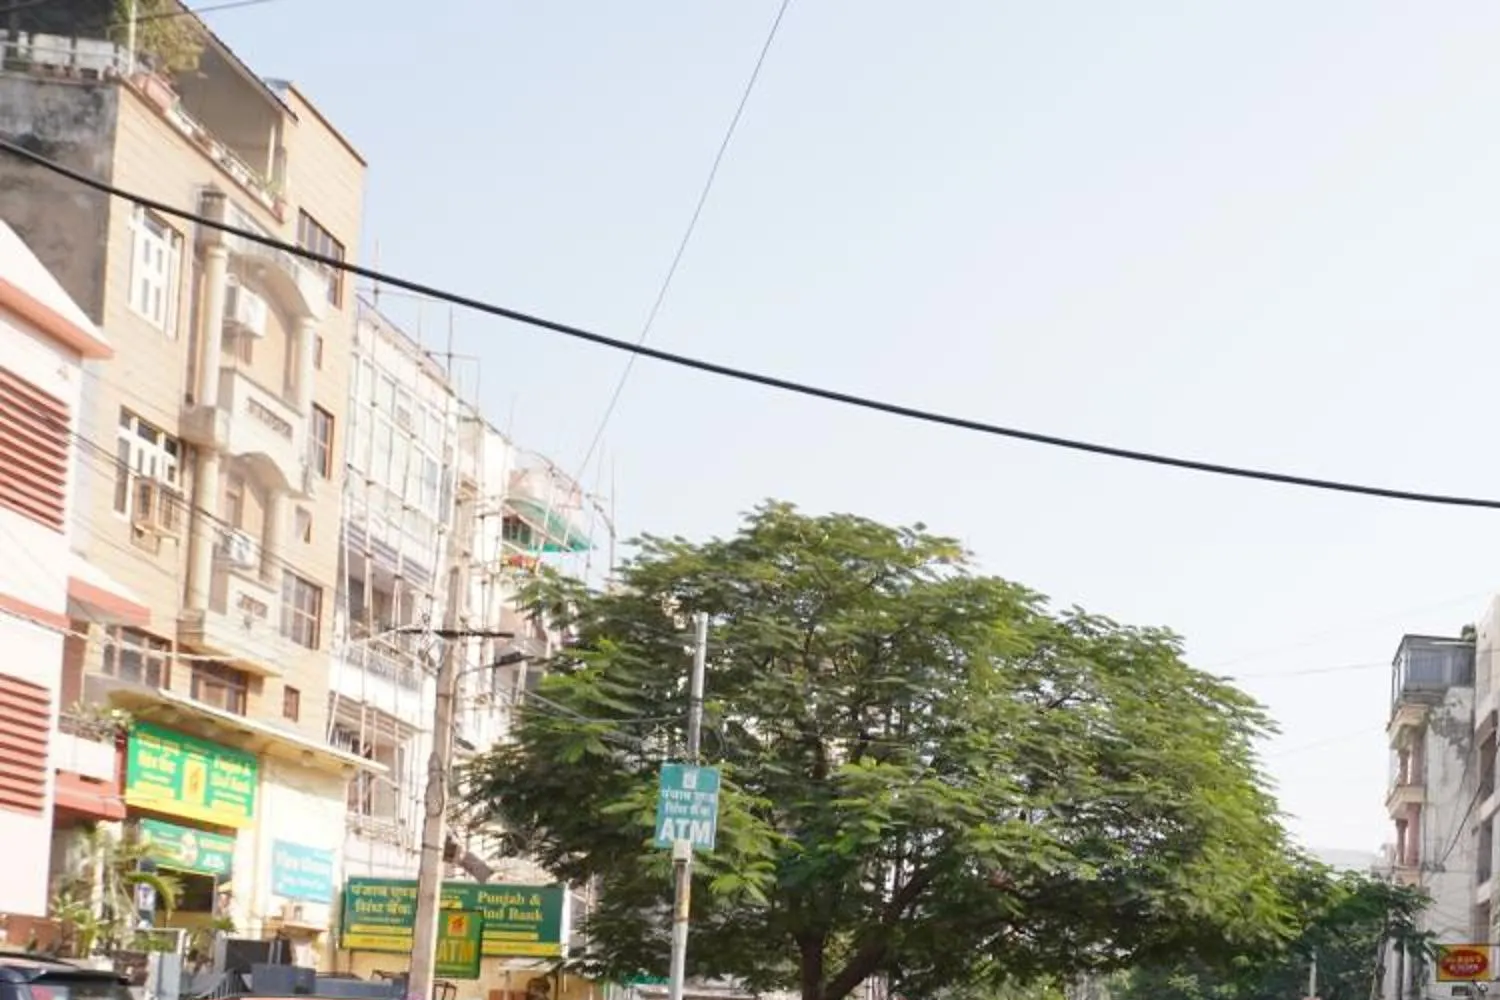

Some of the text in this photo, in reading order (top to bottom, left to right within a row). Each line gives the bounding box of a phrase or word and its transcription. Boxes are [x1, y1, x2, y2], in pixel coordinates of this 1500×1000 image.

[660, 818, 712, 844] ATM
[477, 891, 525, 908] Punjab
[529, 893, 542, 907] &
[508, 906, 543, 922] Bank
[437, 939, 476, 963] ATM
